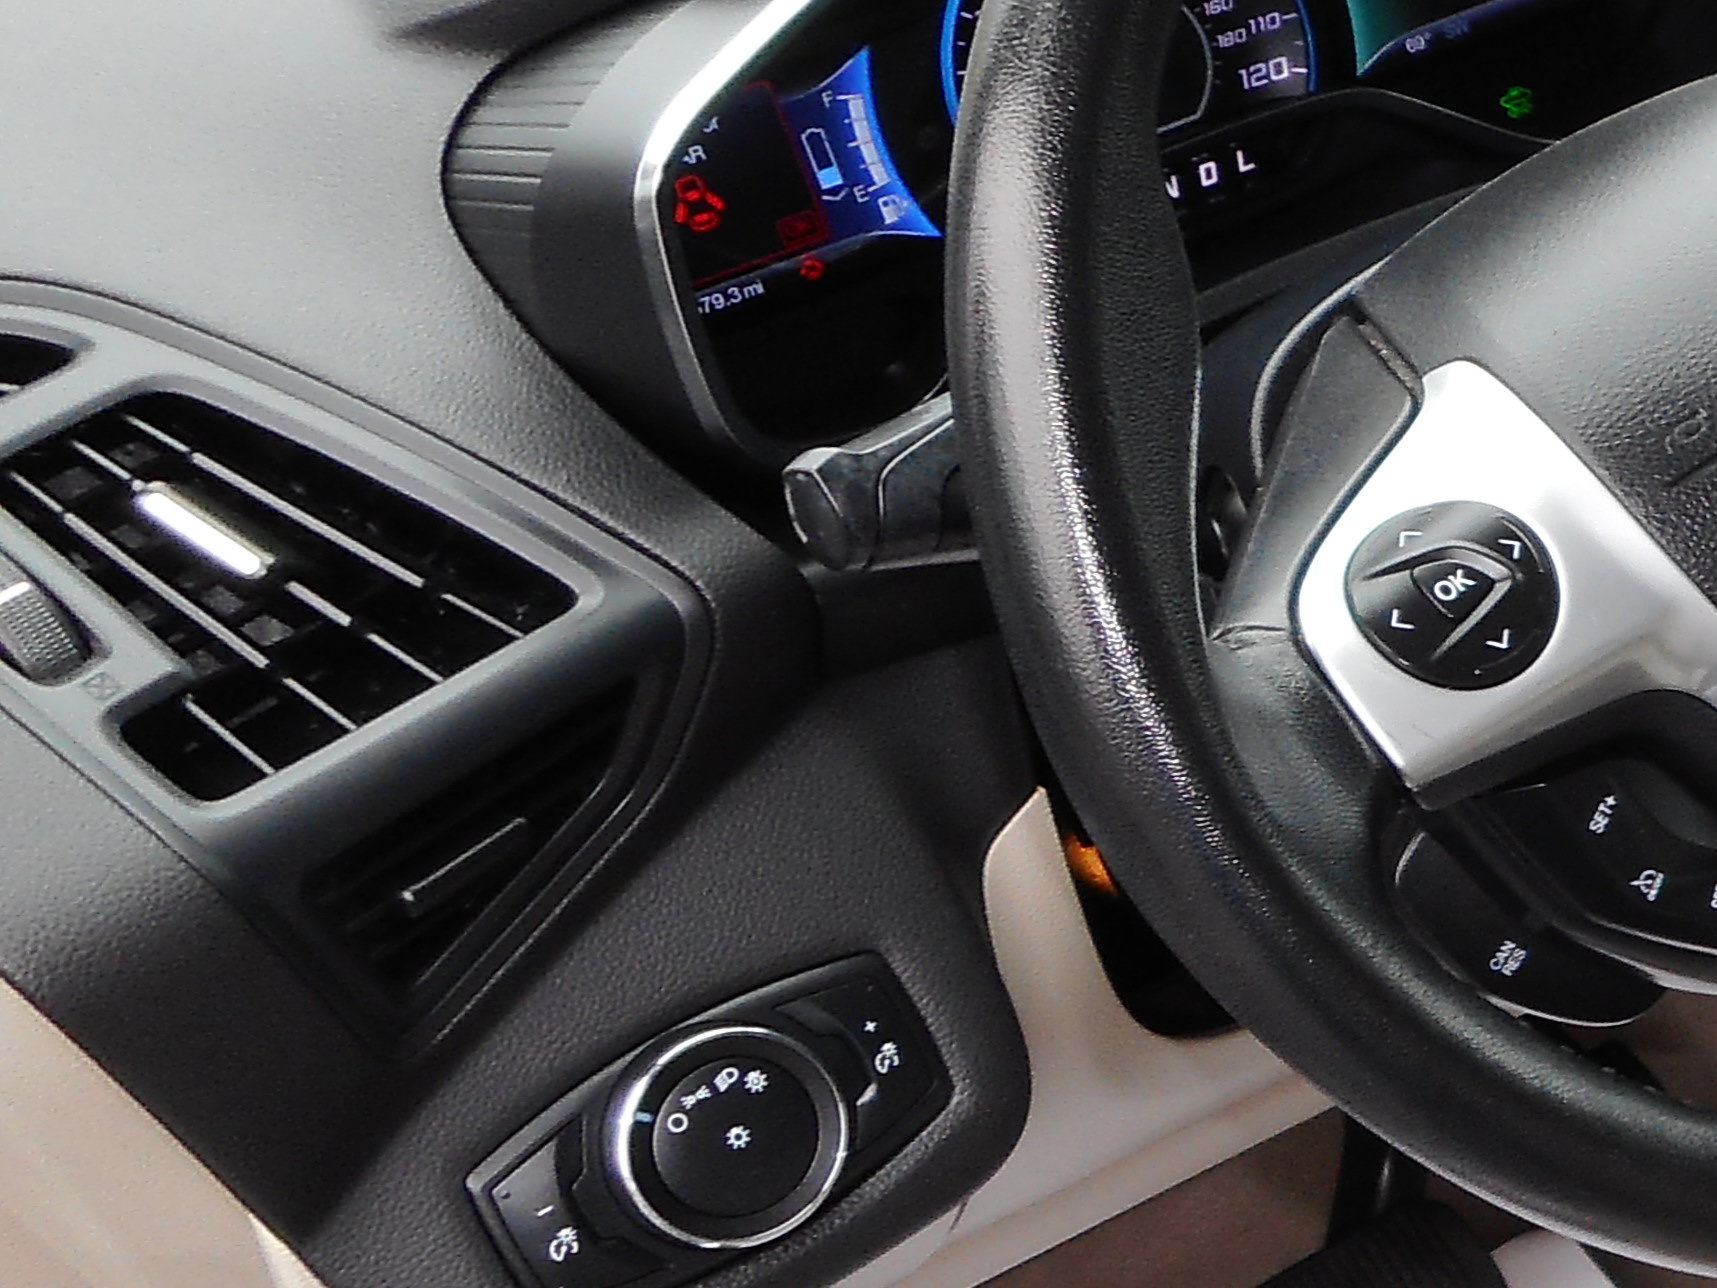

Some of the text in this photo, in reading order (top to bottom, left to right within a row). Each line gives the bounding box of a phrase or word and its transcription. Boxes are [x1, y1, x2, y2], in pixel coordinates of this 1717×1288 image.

[1248, 12, 1281, 33] 110
[1216, 28, 1246, 48] 180
[1238, 56, 1289, 90] 120
[821, 91, 835, 108] F
[1236, 150, 1256, 173] L
[853, 185, 869, 203] E
[698, 279, 765, 314] 79.3 mi
[1433, 569, 1478, 603] OK
[1588, 795, 1617, 834] SET+
